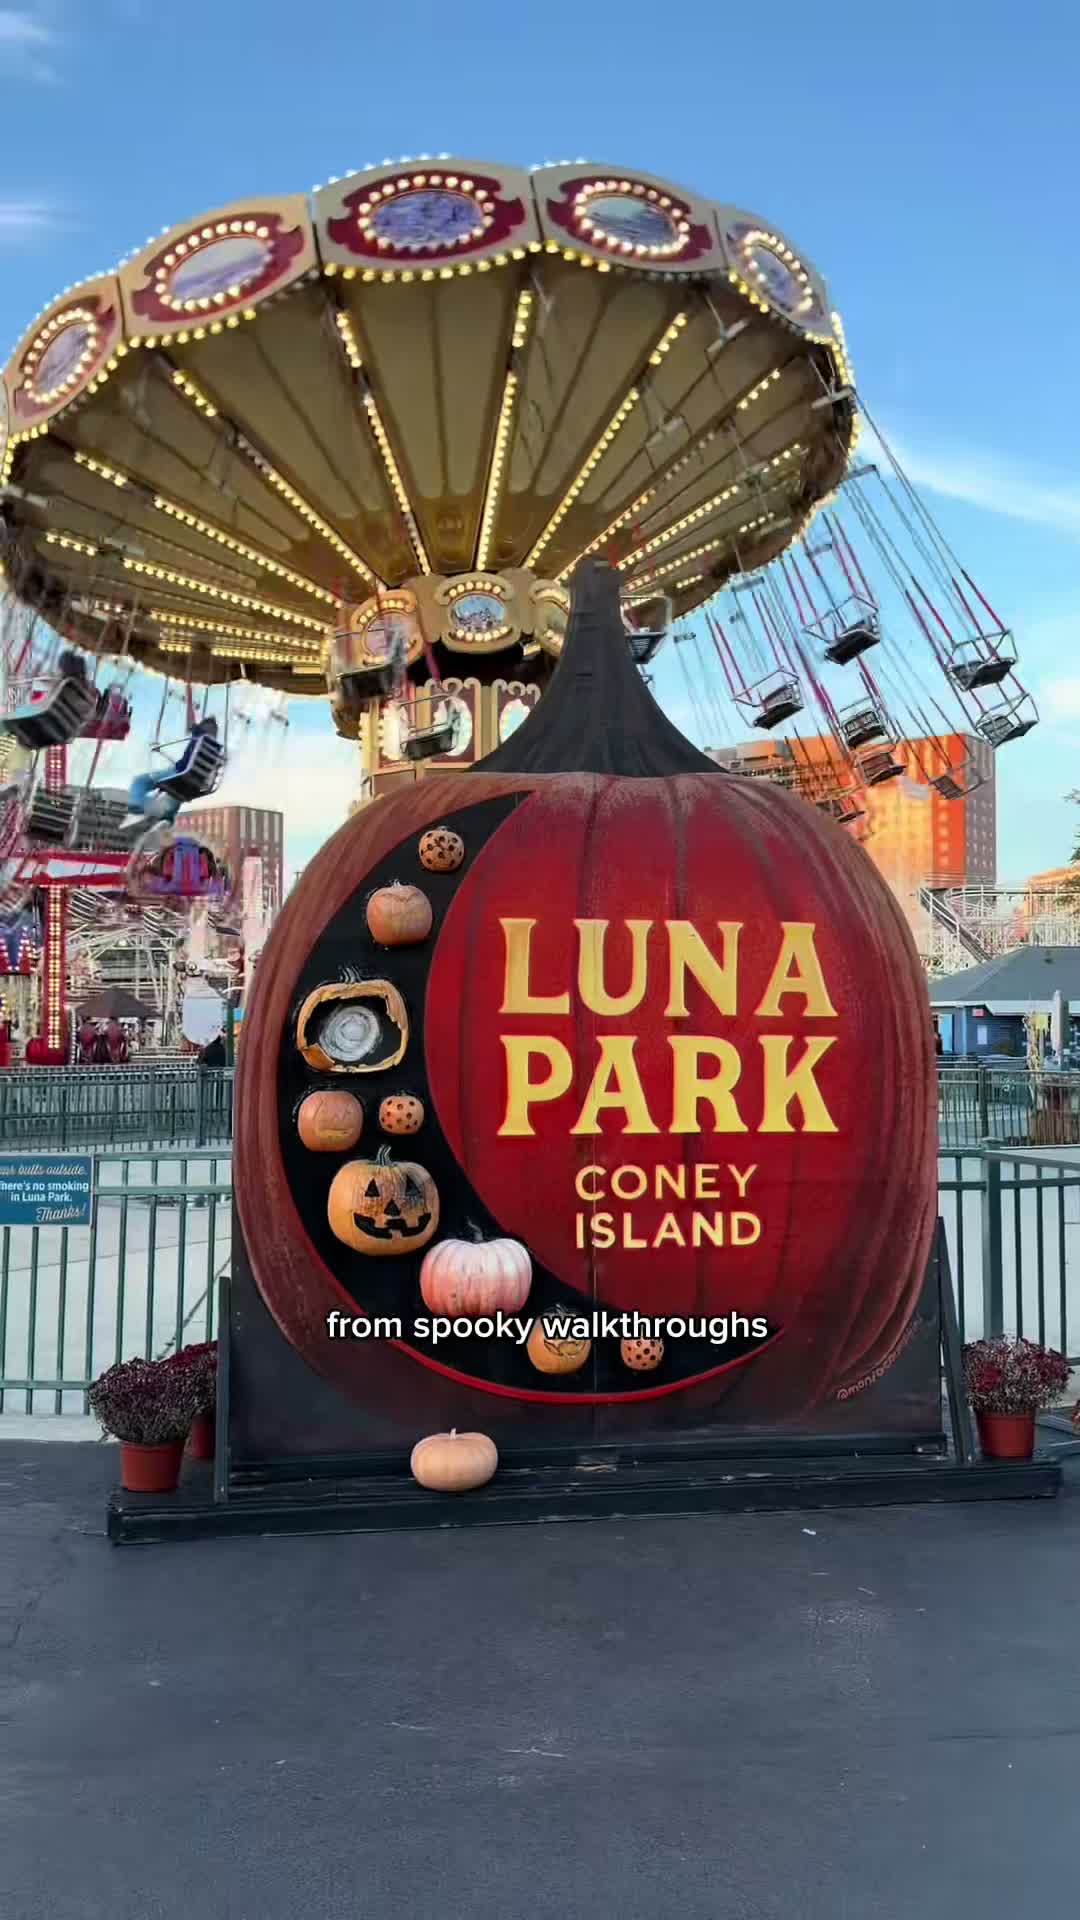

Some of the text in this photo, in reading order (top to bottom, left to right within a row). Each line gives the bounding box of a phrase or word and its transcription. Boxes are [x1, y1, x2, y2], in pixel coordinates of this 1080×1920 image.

[498, 917, 839, 1018] LUNA
[497, 1034, 840, 1136] PARK
[11, 1192, 72, 1202] in Luna Park.
[33, 1183, 45, 1191] no
[48, 1181, 89, 1192] smoking
[575, 1163, 759, 1202] CONEY
[36, 1203, 86, 1222] Thanks!
[575, 1211, 762, 1249] ISLAND
